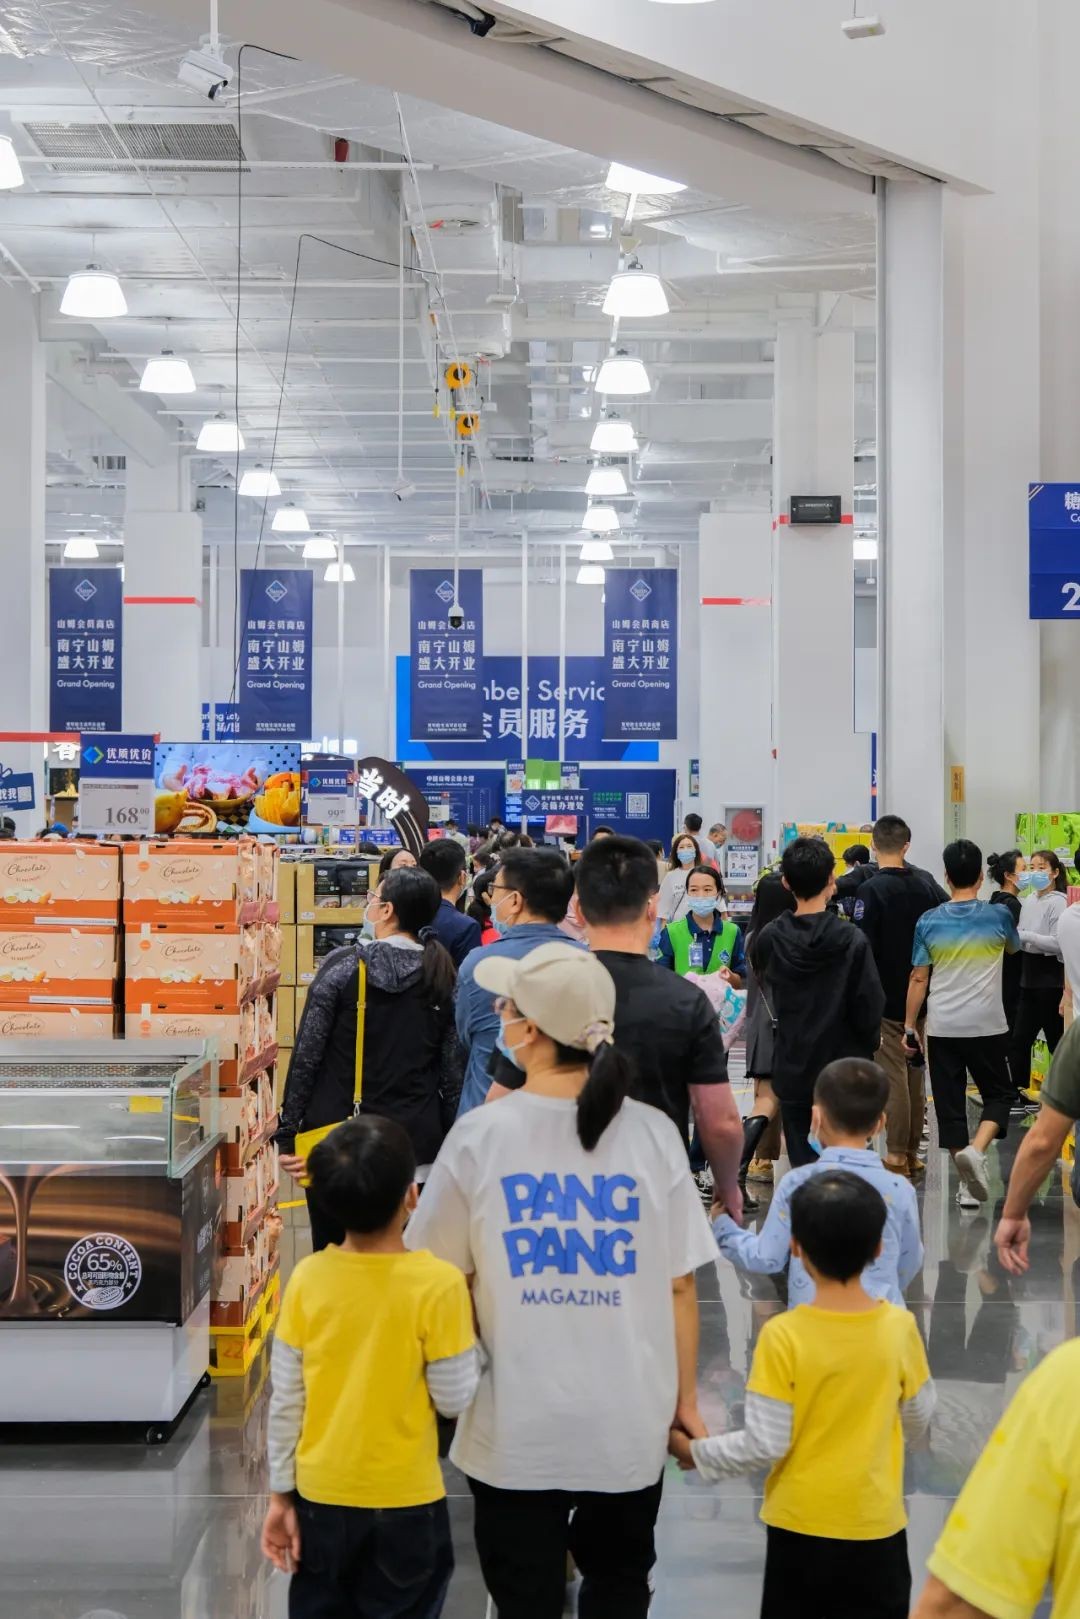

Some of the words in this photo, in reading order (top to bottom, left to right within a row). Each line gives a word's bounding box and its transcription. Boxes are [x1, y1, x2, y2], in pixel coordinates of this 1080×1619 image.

[1061, 582, 1080, 611] 2
[57, 638, 115, 653] 南宁山姆
[247, 640, 305, 654] 南宁山姆
[418, 640, 476, 654] 南宁山姆
[612, 639, 669, 653] 南宁山姆
[57, 656, 115, 670] 盛大开业
[247, 656, 305, 670] 盛大开业
[418, 656, 476, 671] 盛大开业
[612, 655, 670, 670] 盛大开业
[56, 679, 81, 688] Grand
[82, 679, 115, 690] Opening
[246, 681, 271, 689] Grand
[273, 681, 305, 690] Opening
[417, 681, 442, 689] Grand
[444, 681, 476, 690] Opening
[611, 679, 636, 688] Grand
[638, 679, 670, 689] Opening
[106, 747, 152, 762] 优质优价
[500, 1172, 640, 1224] PANG
[68, 1240, 94, 1280] COCOA
[95, 1236, 139, 1279] CONTENT
[502, 1227, 637, 1279] PANG
[87, 1253, 123, 1271] 65%
[521, 1288, 622, 1307] MAGAZINE
